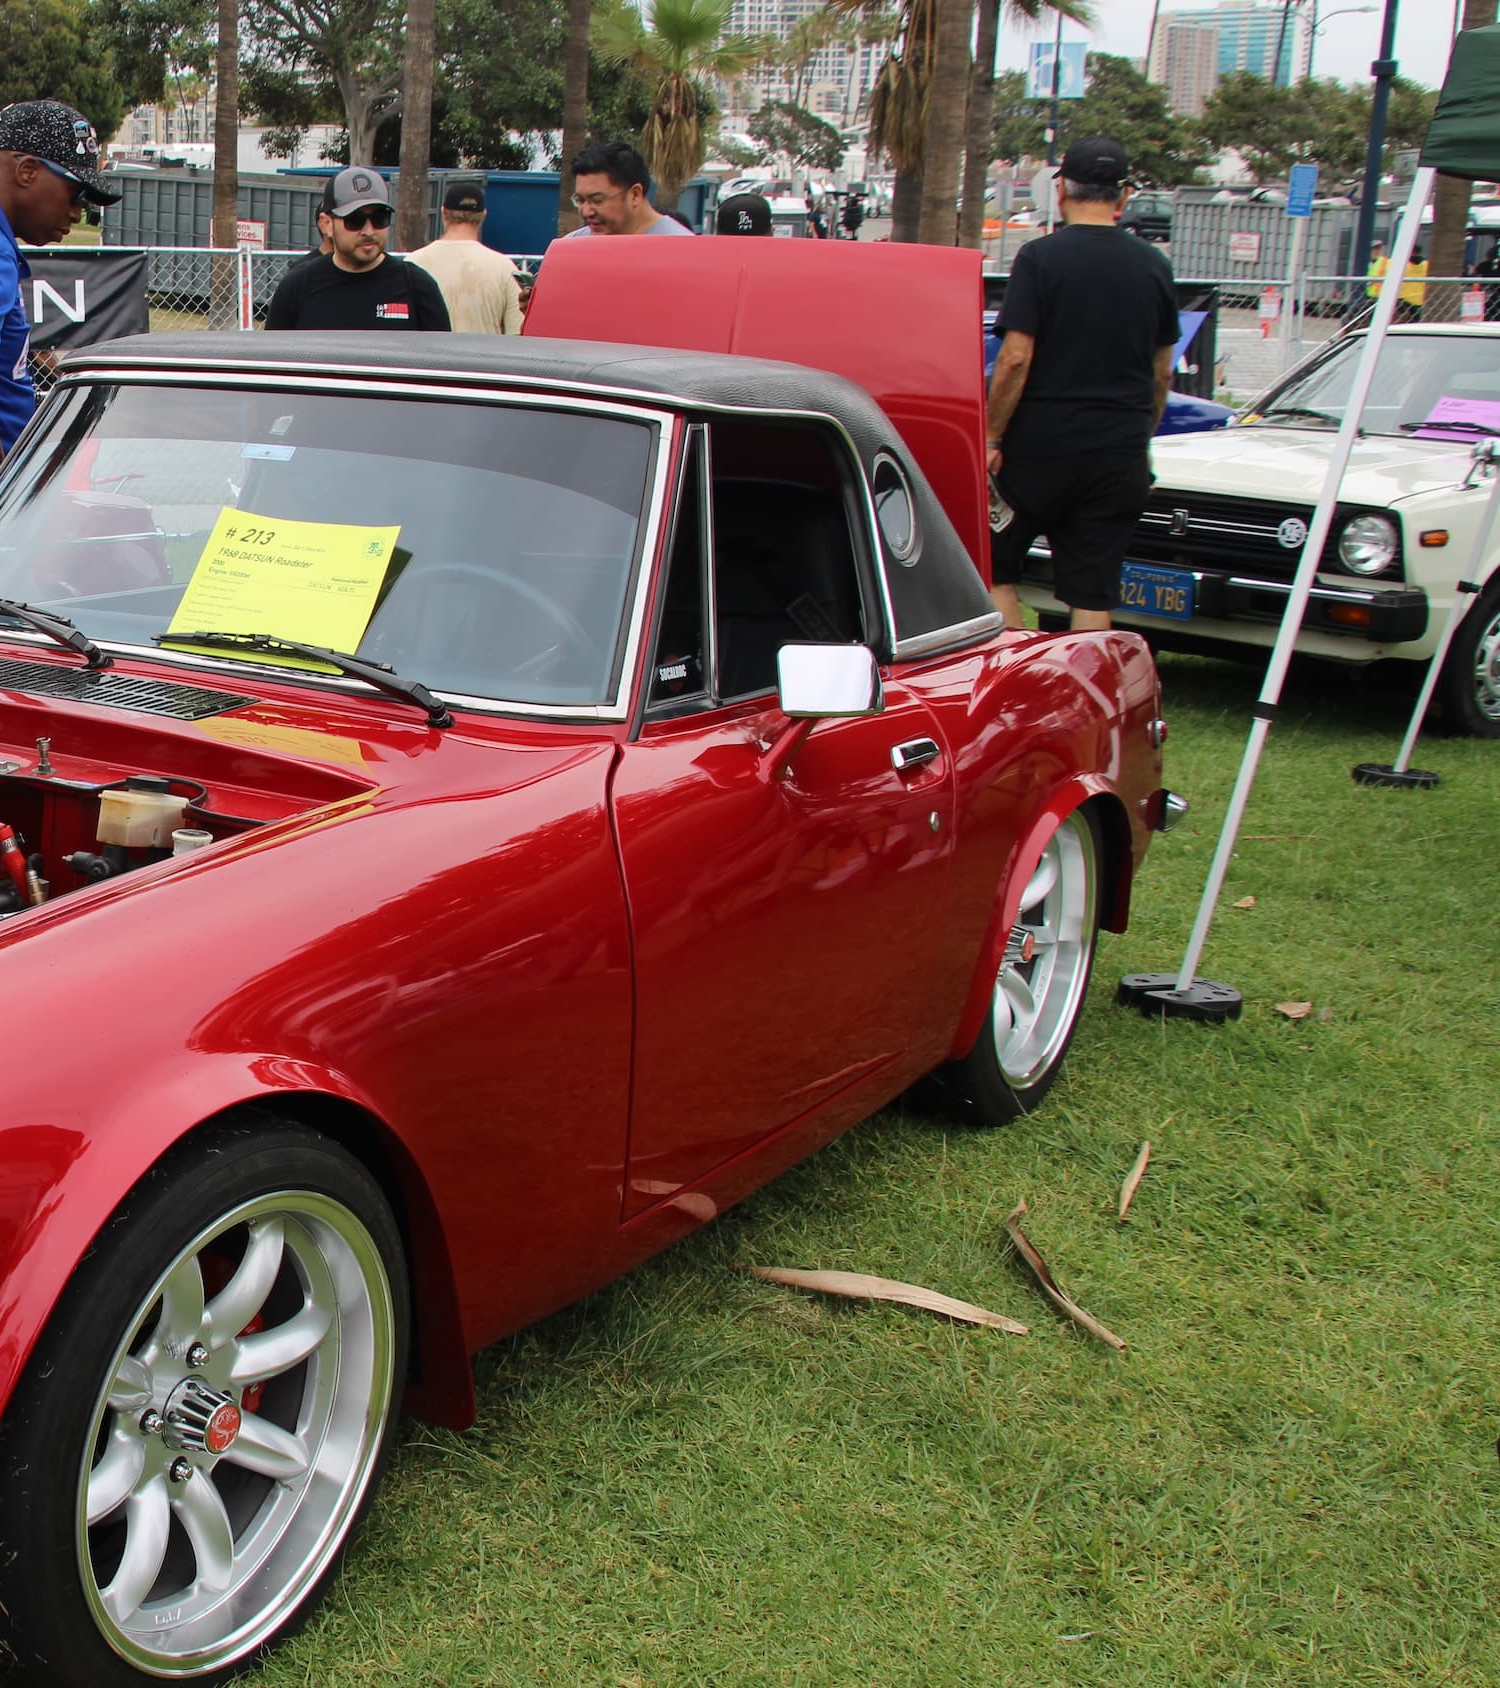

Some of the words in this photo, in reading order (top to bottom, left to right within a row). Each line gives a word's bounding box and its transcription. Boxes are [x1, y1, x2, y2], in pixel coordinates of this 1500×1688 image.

[225, 526, 238, 539] #
[240, 528, 276, 545] 213
[238, 551, 275, 564] DATSUN
[275, 556, 314, 569] Roadster
